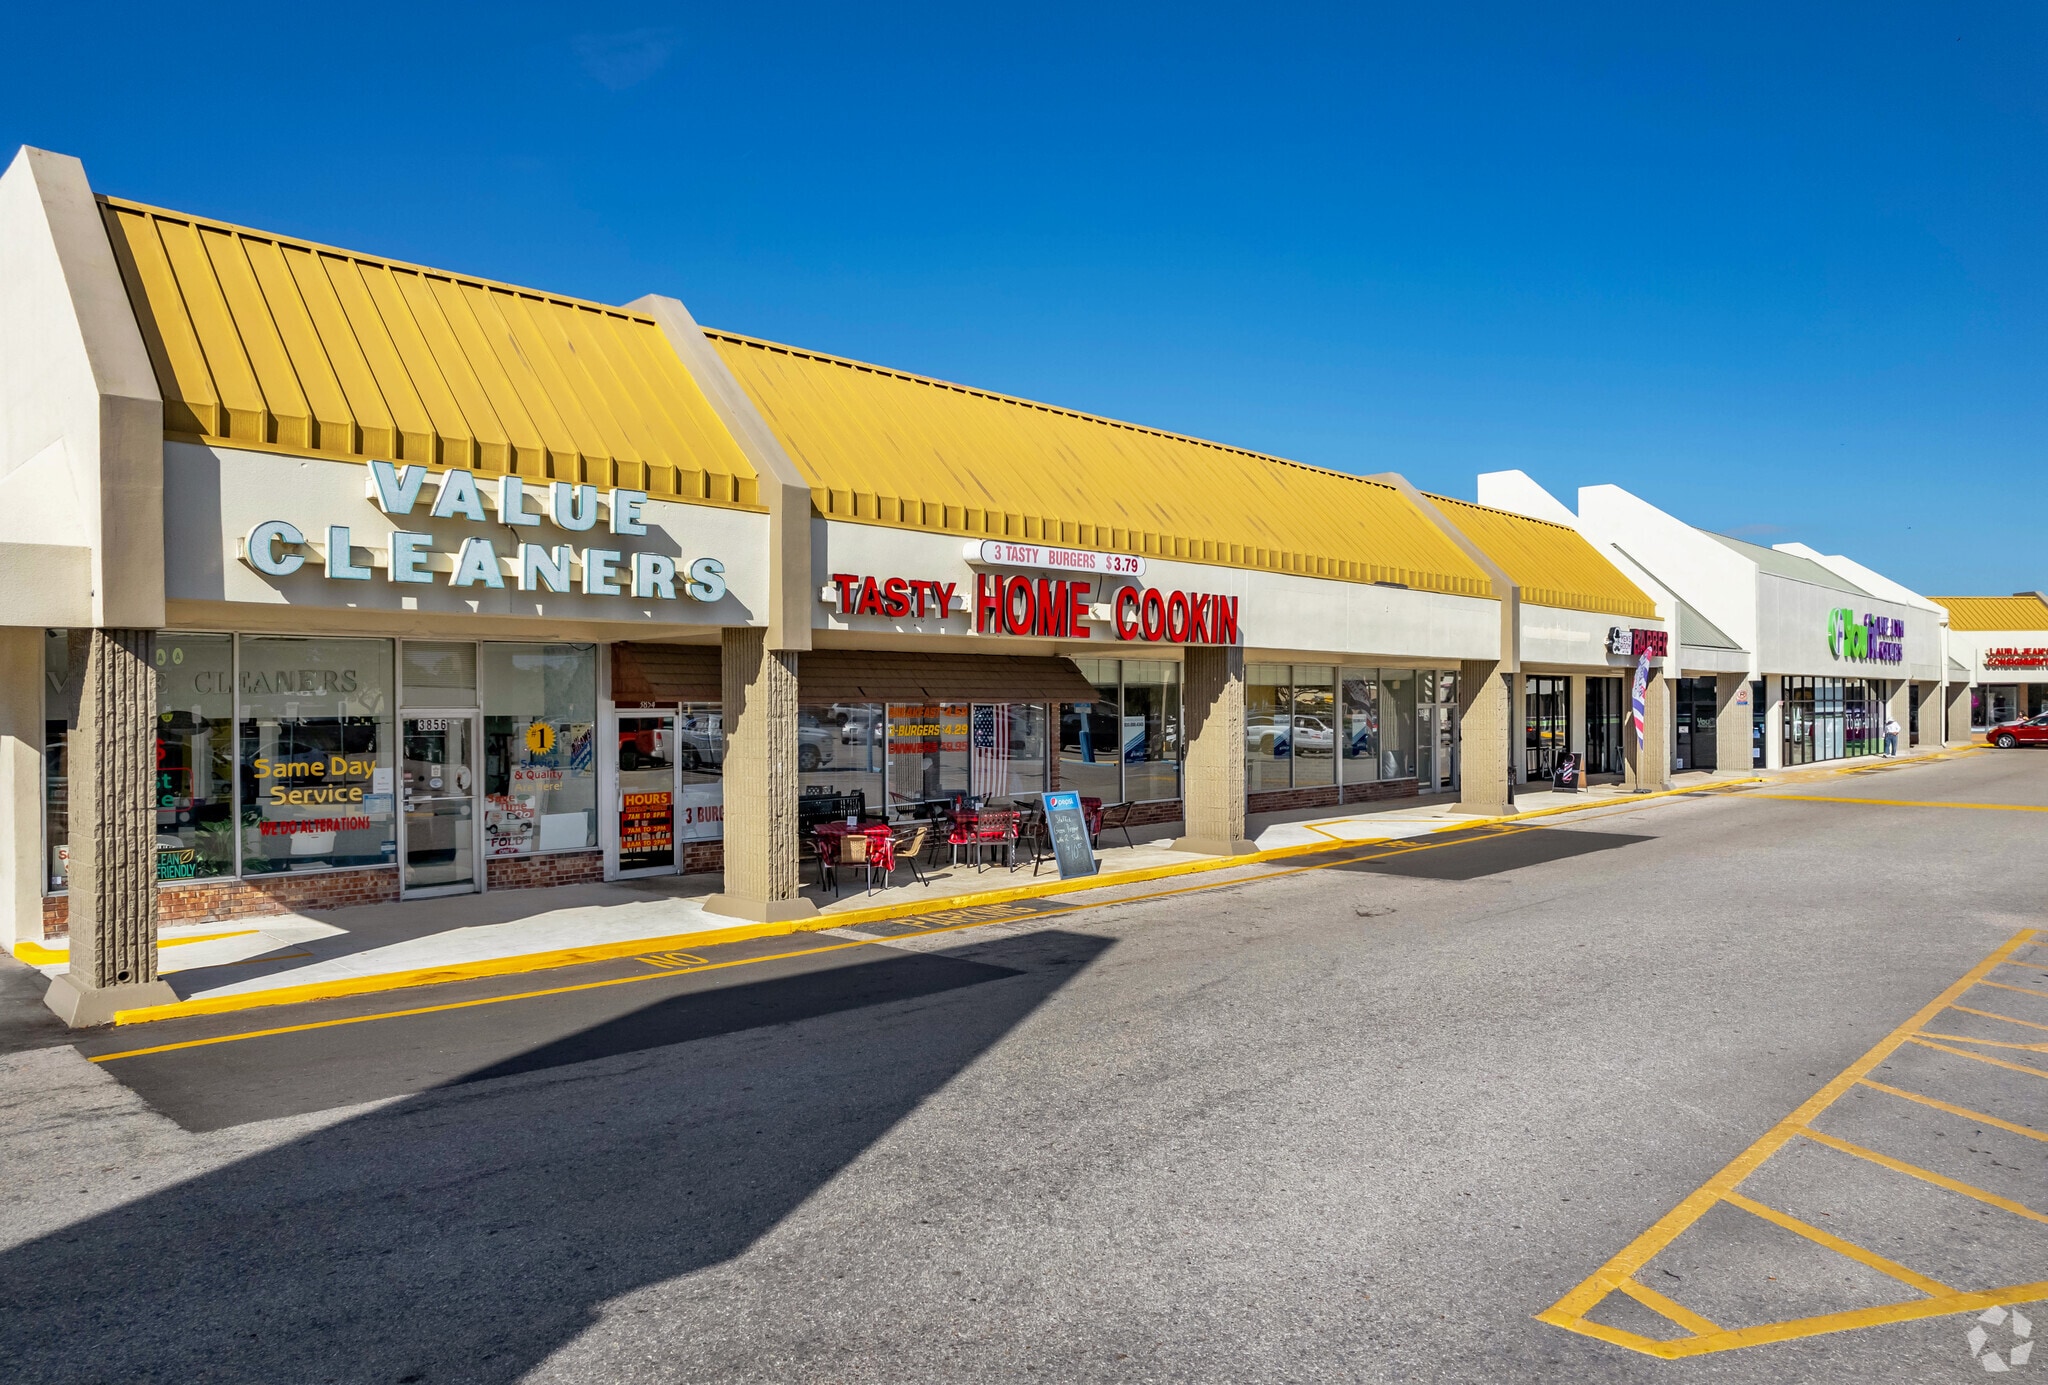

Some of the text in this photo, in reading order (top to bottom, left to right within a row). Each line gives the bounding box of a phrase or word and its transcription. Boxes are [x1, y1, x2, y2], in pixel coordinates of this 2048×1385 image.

[367, 460, 648, 536] VALUE
[242, 520, 727, 602] CLEANERS
[994, 544, 1002, 560] 3
[1006, 546, 1039, 564] TASTY
[1048, 550, 1096, 568] BURGERS
[832, 573, 956, 619] TASTY
[975, 573, 1238, 644] HOME COOKIN
[1632, 629, 1668, 656] BARBER
[1990, 647, 2019, 656] LAURA
[194, 670, 358, 696] CLEANERS
[888, 706, 940, 718] BREAKFAST
[419, 719, 447, 730] 3856
[254, 756, 376, 779] Same Day
[520, 760, 559, 769] Service
[514, 770, 563, 780] & Quality
[270, 784, 362, 805] Service
[515, 782, 563, 792] Are Here!
[626, 793, 668, 805] HOURS
[1058, 798, 1073, 806] pepsi
[685, 807, 692, 824] 3
[260, 816, 370, 836] WE DO ALTERATIONS
[491, 837, 523, 847] FOLD
[890, 904, 1038, 929] PARKING
[634, 952, 709, 970] NO
